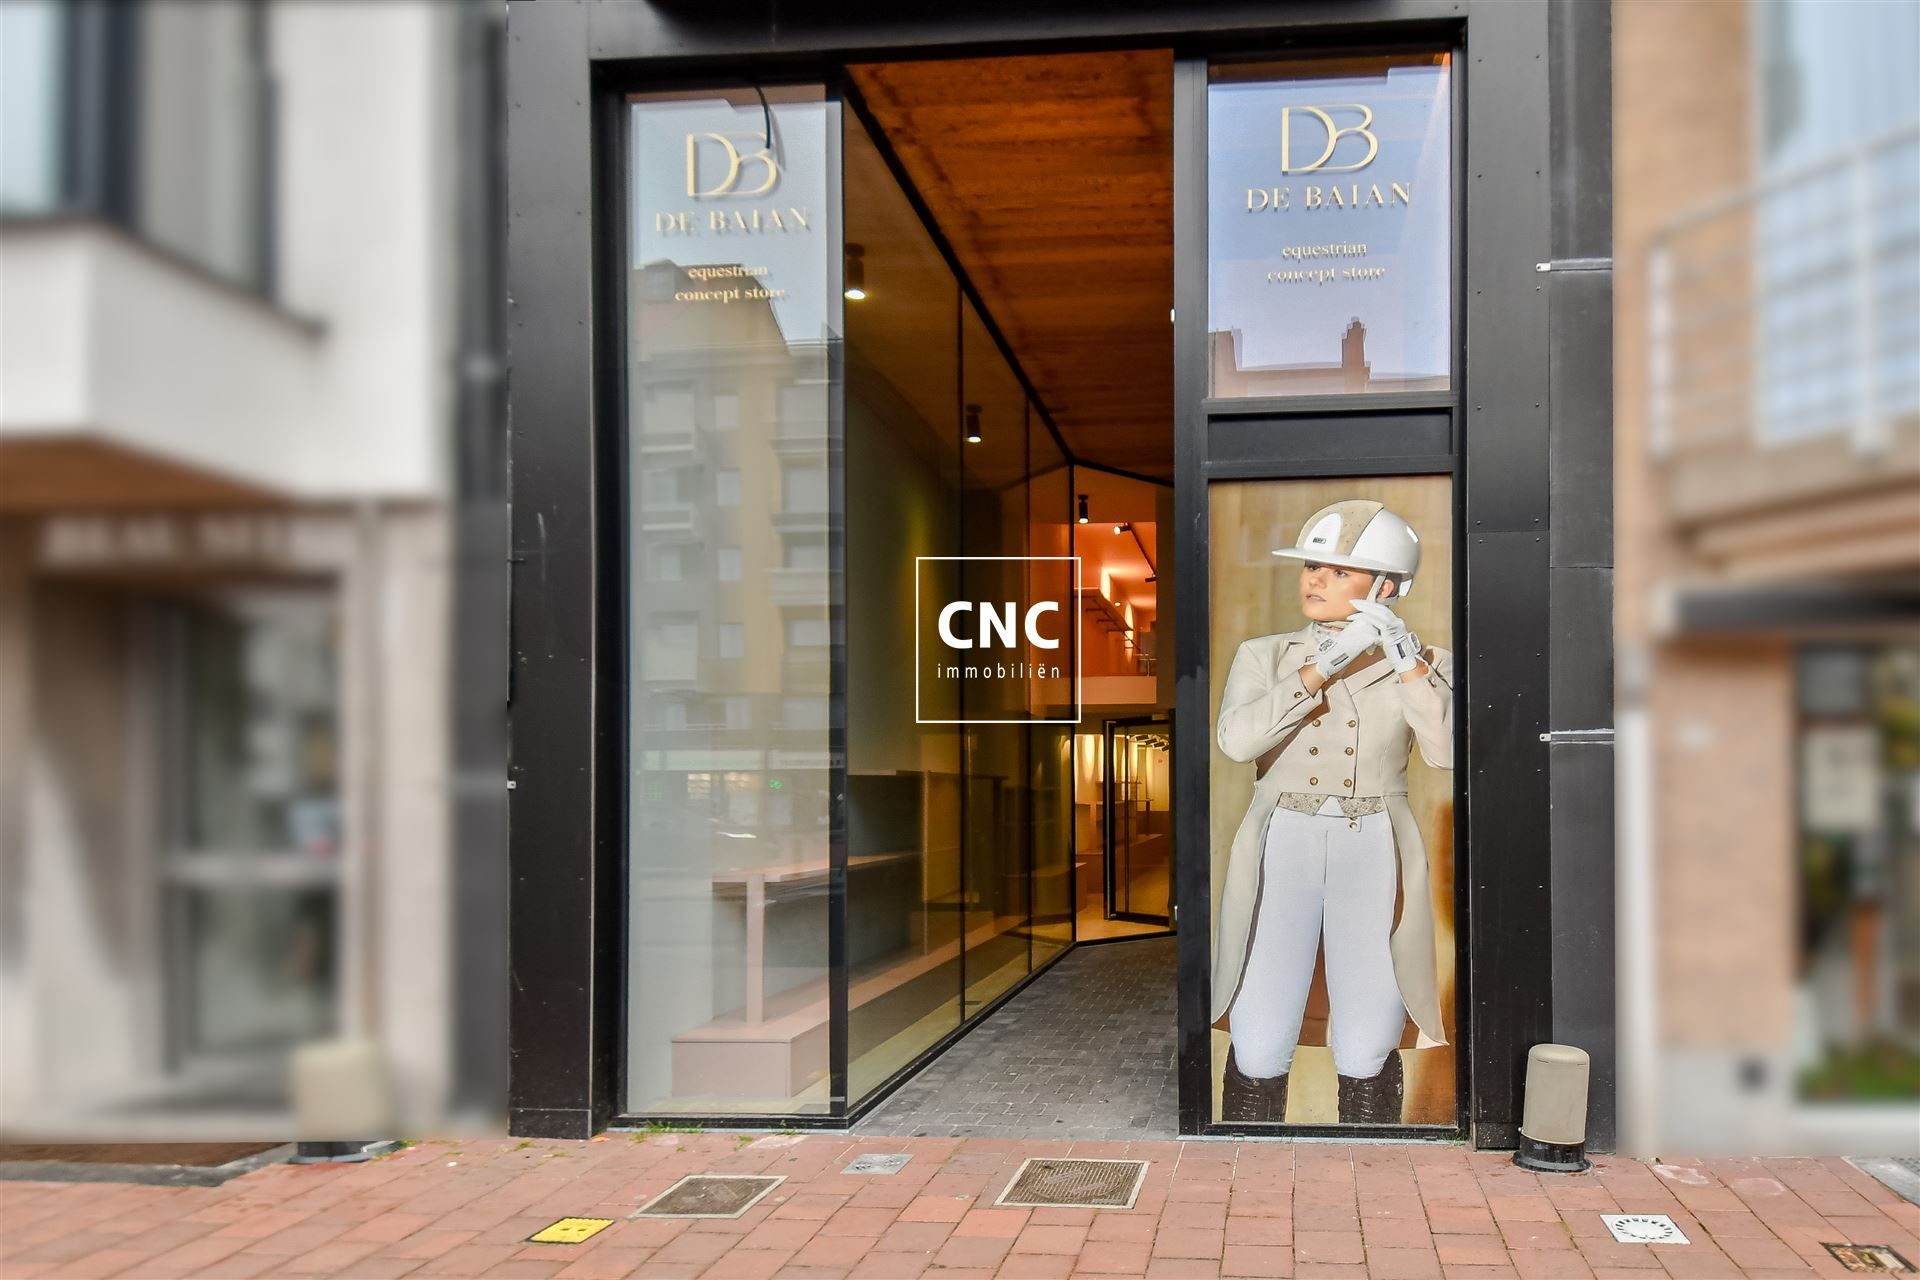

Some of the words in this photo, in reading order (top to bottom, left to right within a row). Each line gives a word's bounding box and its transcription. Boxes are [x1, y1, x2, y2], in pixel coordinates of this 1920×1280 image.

[1282, 103, 1378, 174] DB
[686, 132, 777, 197] DB
[1247, 187, 1290, 210] DE
[1306, 182, 1411, 206] BAIAN
[655, 212, 695, 232] DE
[709, 207, 809, 231] BAIAN
[1282, 241, 1367, 260] equestrian
[688, 265, 769, 281] equestrian
[1267, 267, 1336, 284] concept
[1342, 266, 1385, 279] store
[675, 287, 741, 303] concept
[744, 286, 785, 300] store
